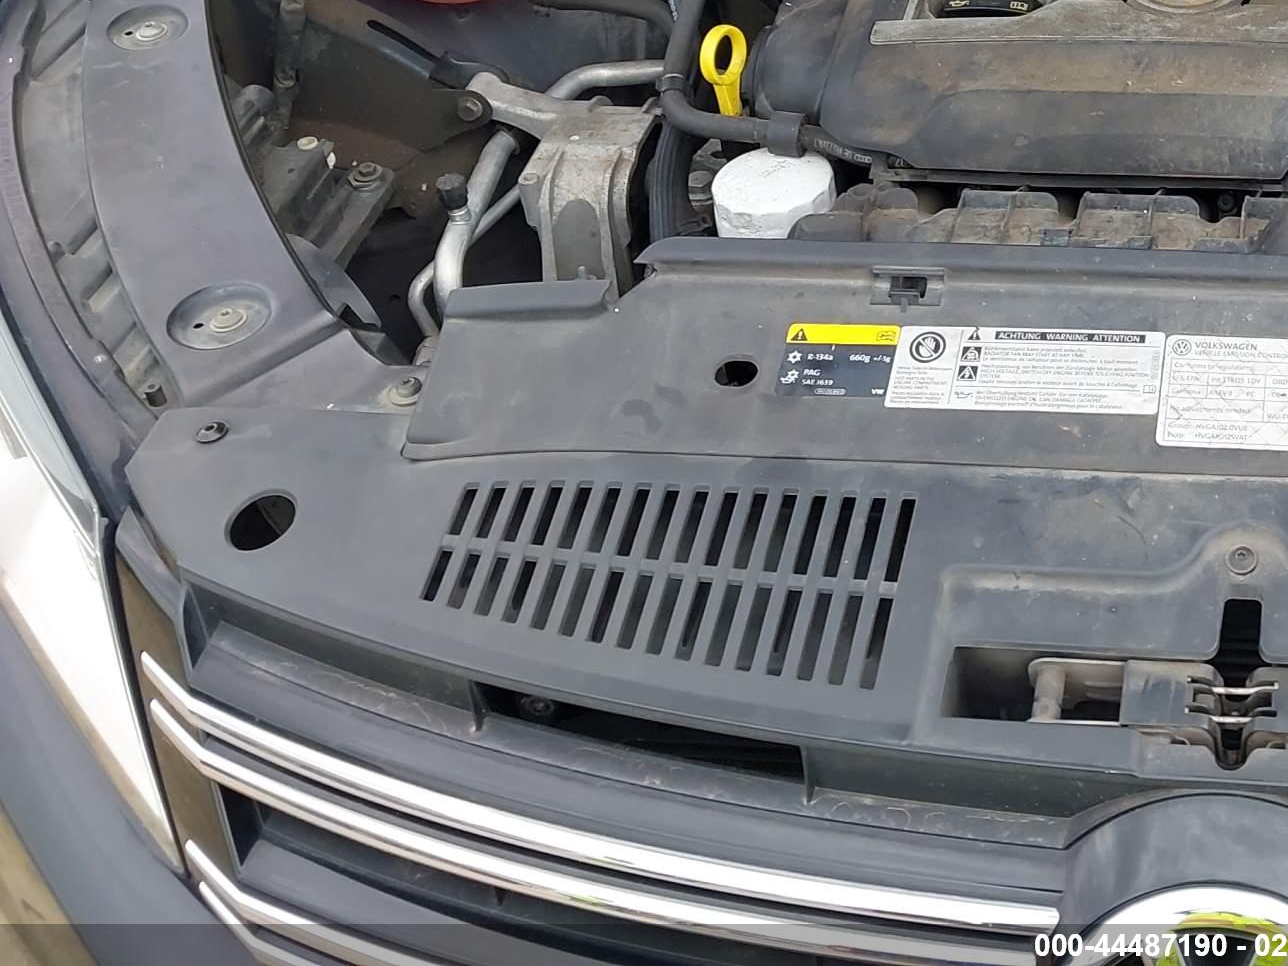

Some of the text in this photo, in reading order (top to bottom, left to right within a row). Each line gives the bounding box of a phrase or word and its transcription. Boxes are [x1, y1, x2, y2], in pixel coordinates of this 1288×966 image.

[999, 332, 1141, 343] ACHTUNG WARNING ATTENTION
[1194, 341, 1257, 351] VOLKSWAGEN
[807, 353, 834, 361] R-134a
[849, 354, 871, 363] 660g
